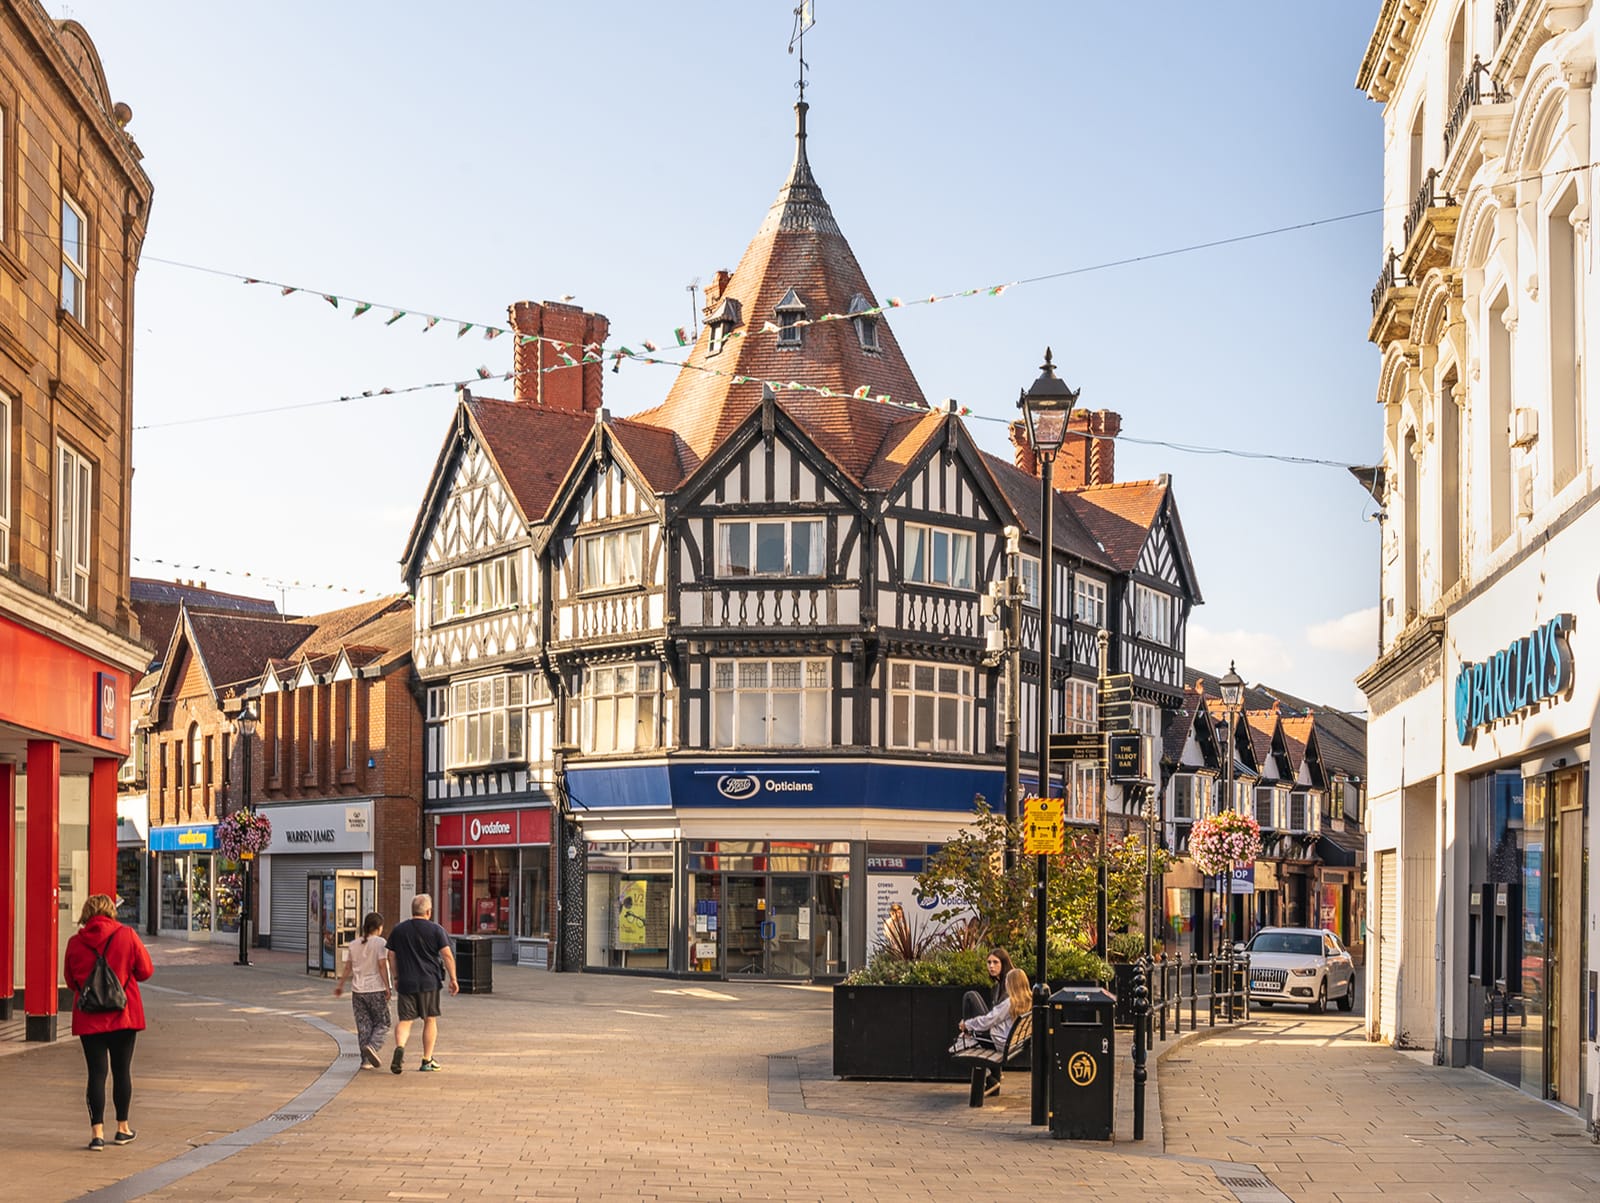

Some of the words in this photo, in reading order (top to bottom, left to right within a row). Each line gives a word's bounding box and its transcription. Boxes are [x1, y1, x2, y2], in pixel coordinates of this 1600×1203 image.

[1472, 613, 1563, 729] BARCLAYS
[103, 684, 114, 713] QD
[1120, 745, 1132, 753] THE
[765, 779, 814, 793] Opticians
[481, 820, 511, 835] vodafone
[285, 830, 312, 843] WARREN
[313, 829, 336, 842] JAMES
